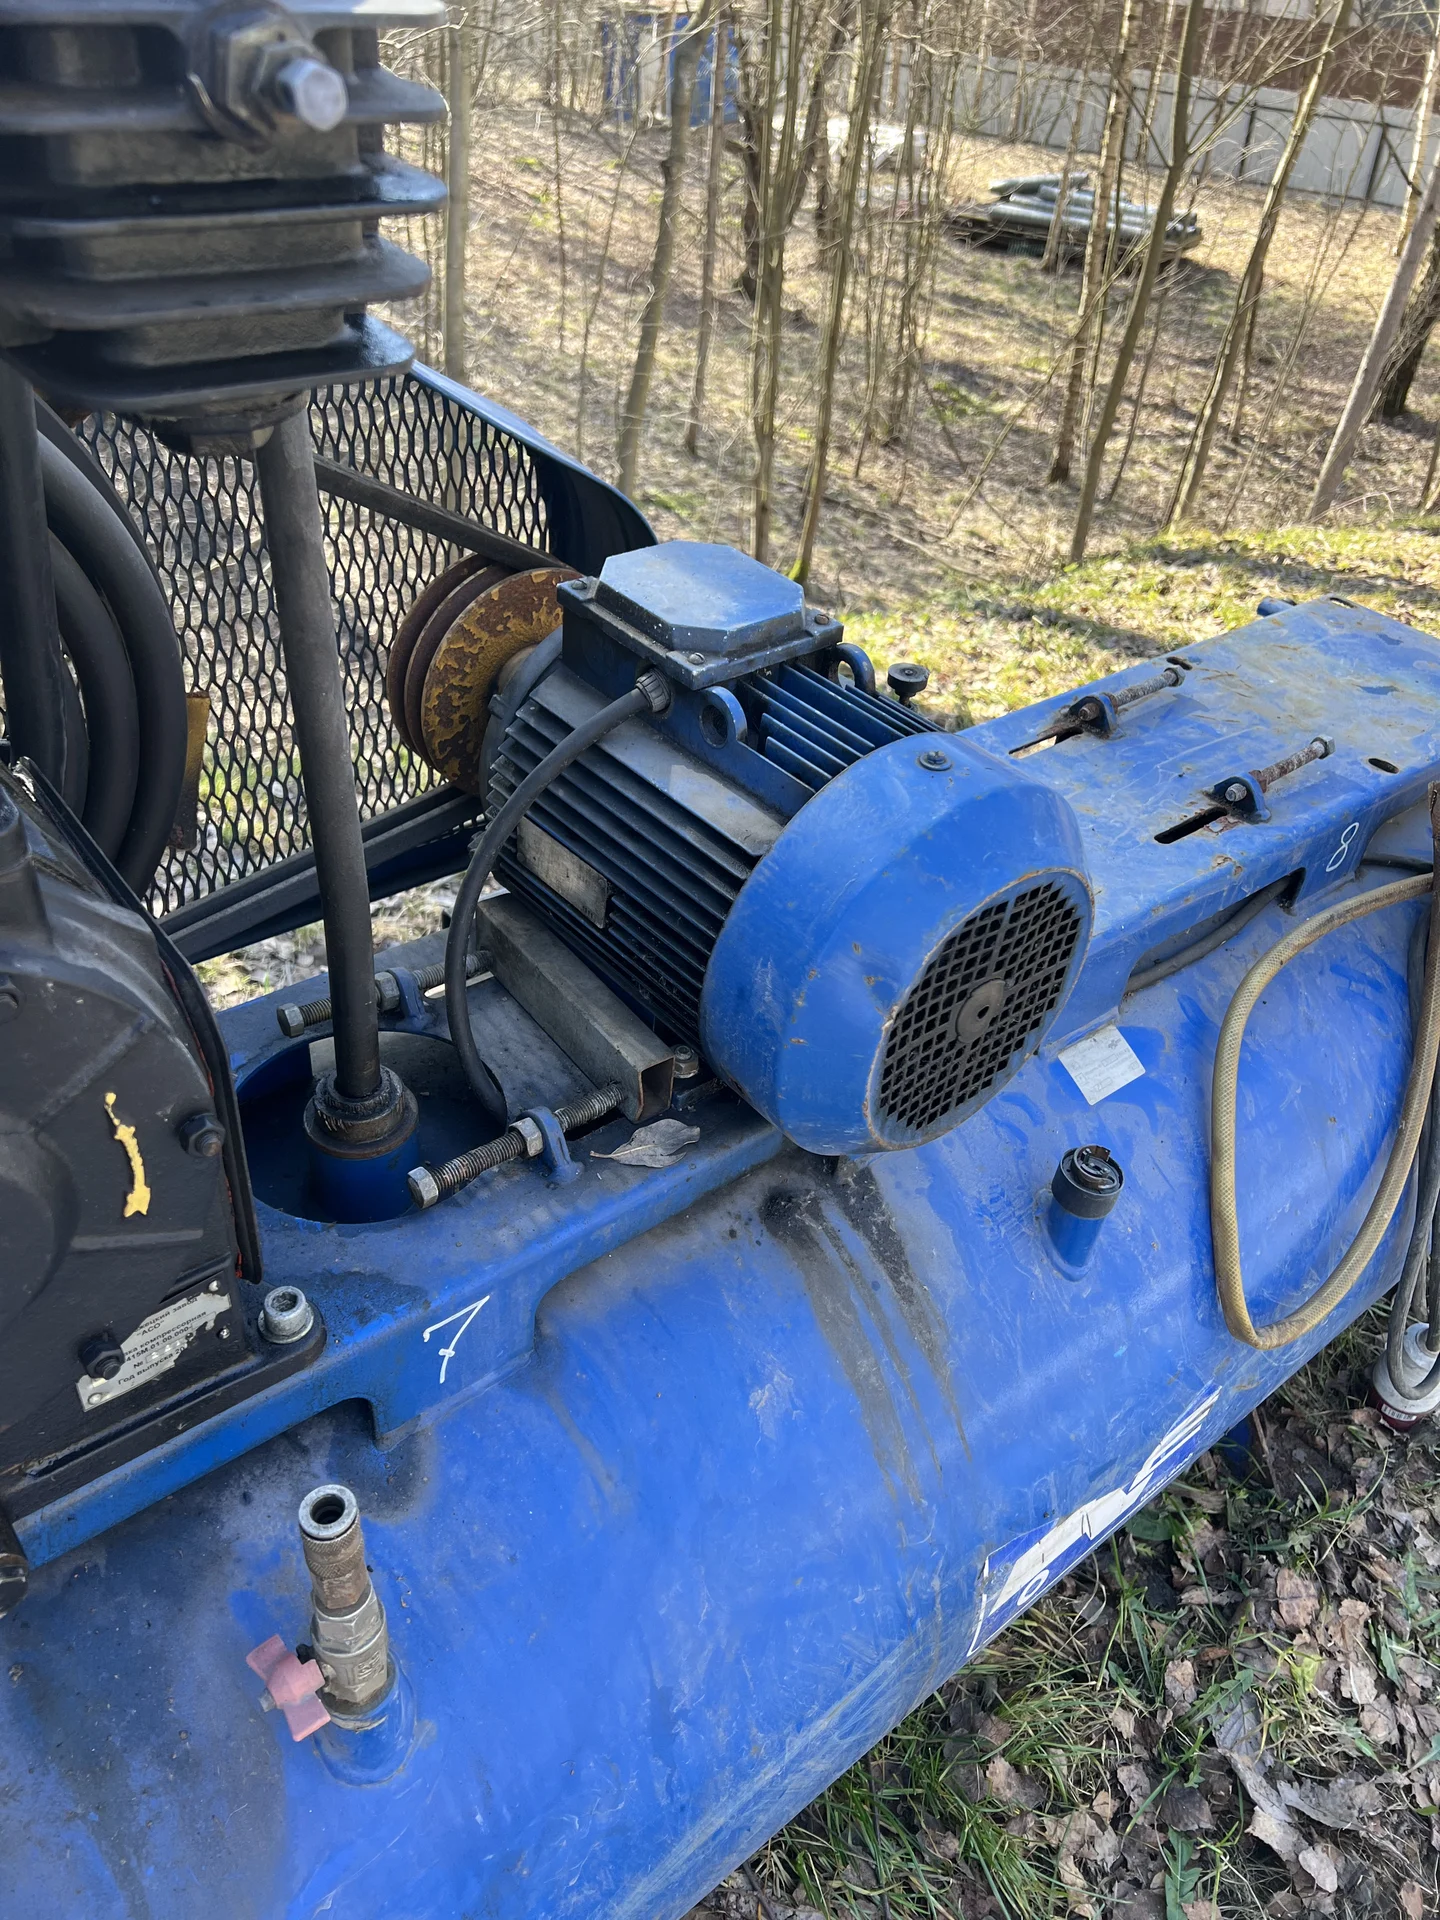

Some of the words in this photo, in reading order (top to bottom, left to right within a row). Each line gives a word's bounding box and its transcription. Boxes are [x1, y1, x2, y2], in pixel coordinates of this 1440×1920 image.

[1326, 822, 1359, 872] 8
[140, 1311, 206, 1349] компрессорная
[423, 1295, 490, 1384] 7
[118, 1374, 136, 1385] Год
[137, 1353, 173, 1376] выпуска
